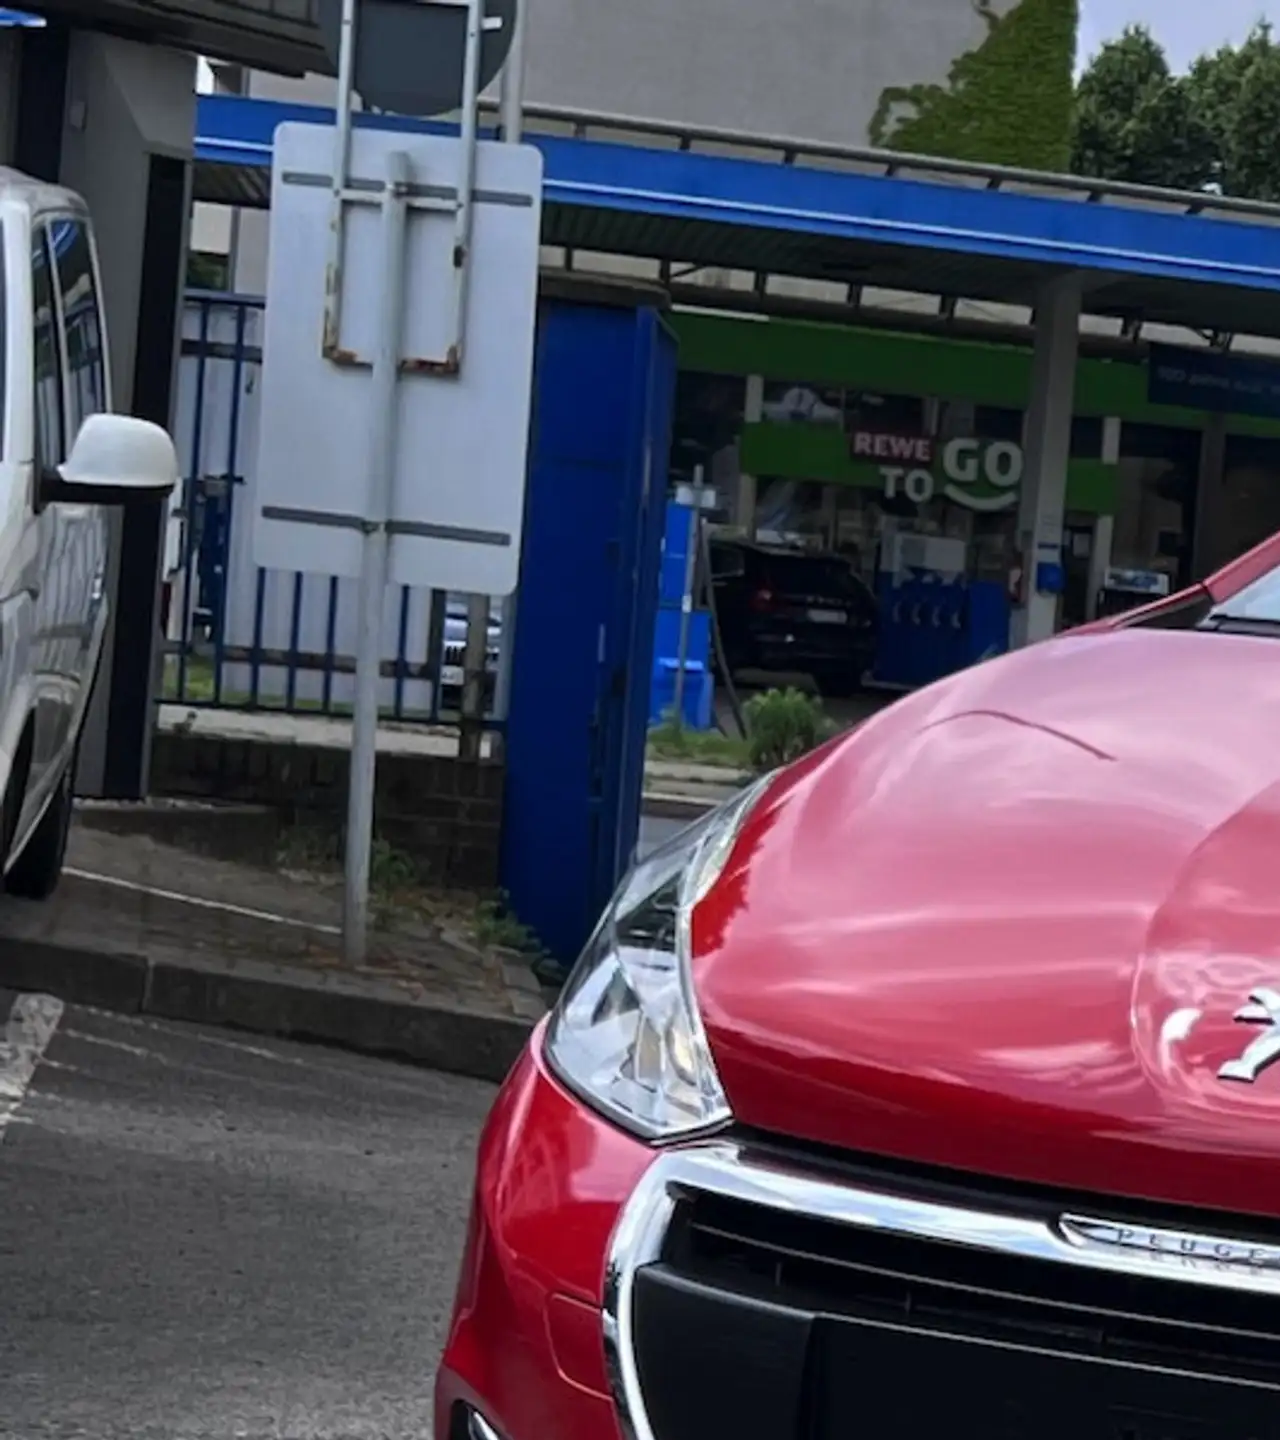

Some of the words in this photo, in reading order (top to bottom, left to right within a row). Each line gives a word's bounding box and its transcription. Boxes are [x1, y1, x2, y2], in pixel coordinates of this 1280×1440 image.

[854, 431, 931, 462] REWE
[879, 466, 934, 502] TO
[943, 438, 1023, 487] GO
